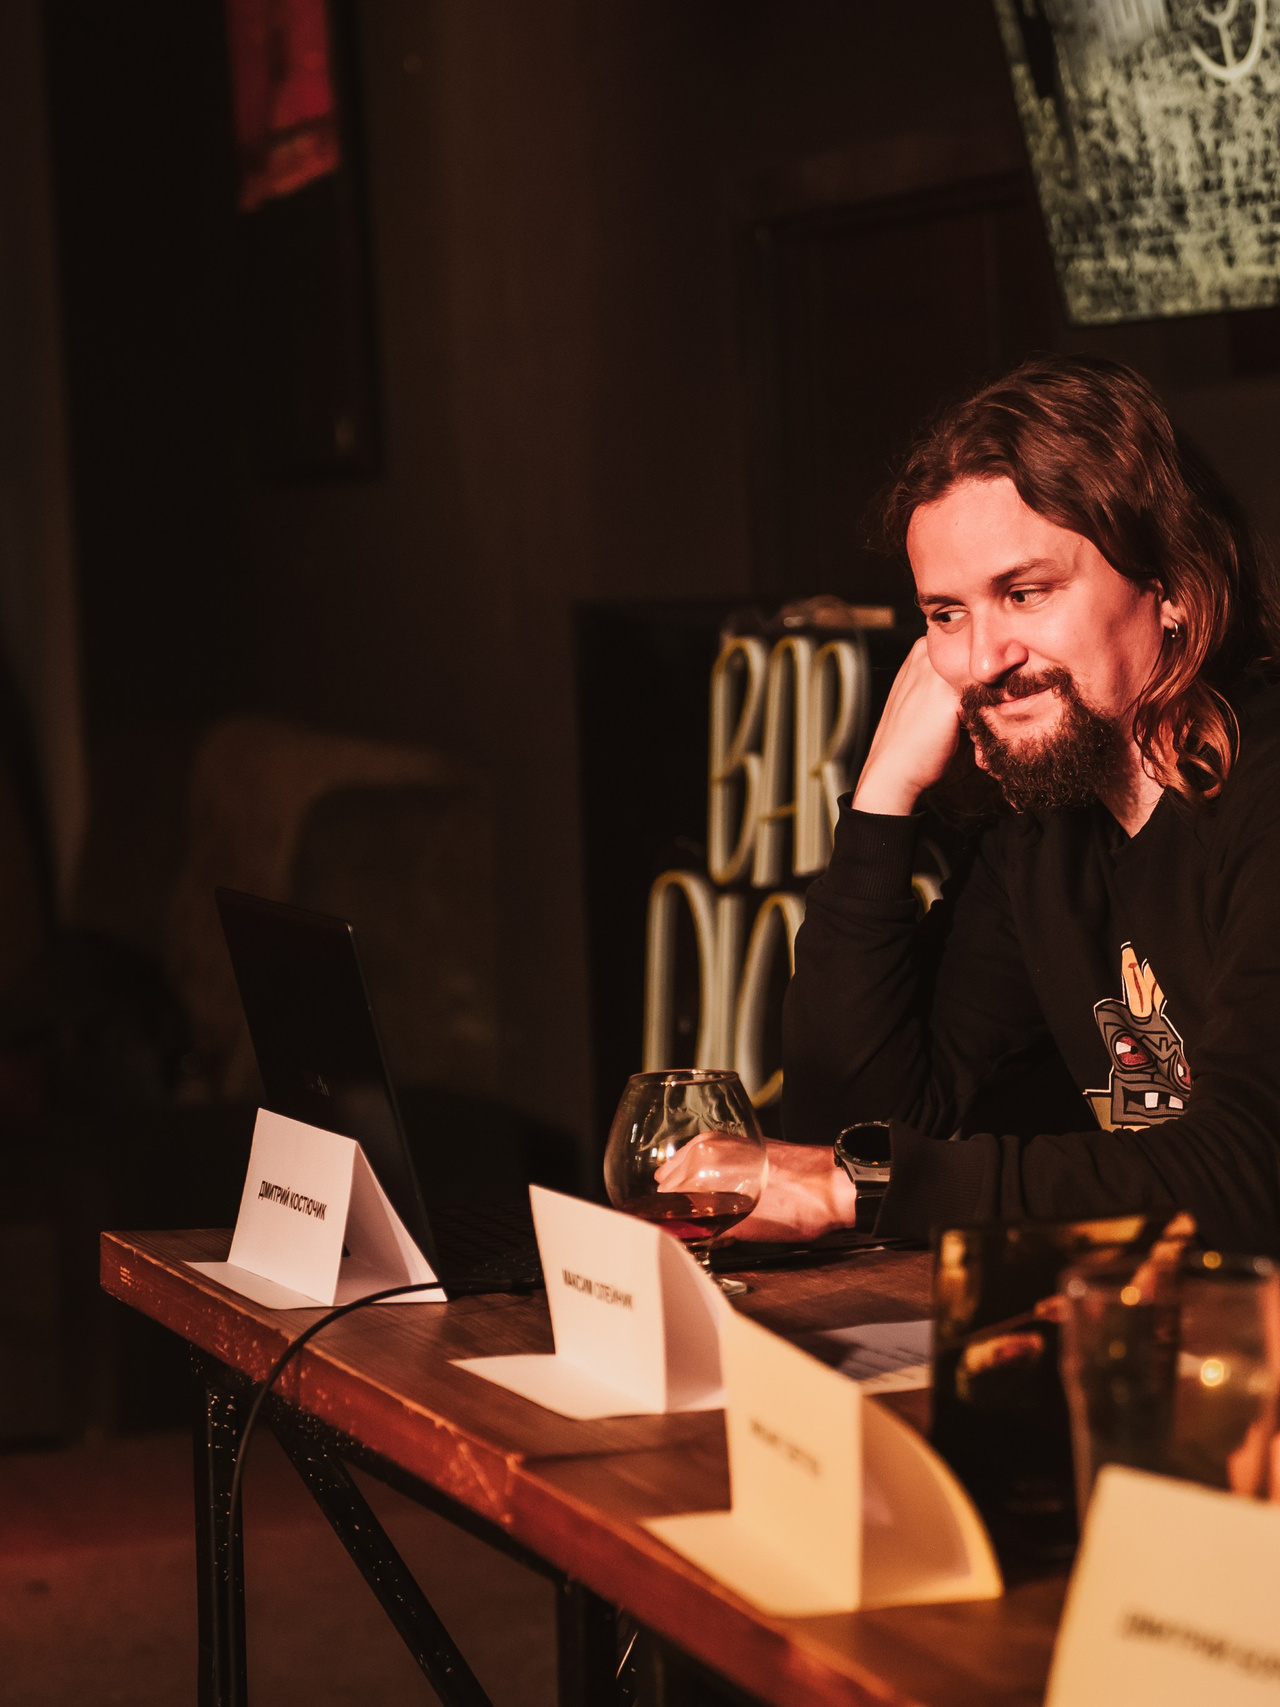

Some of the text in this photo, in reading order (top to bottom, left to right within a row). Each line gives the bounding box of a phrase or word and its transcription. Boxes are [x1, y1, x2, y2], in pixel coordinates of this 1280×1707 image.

[707, 634, 864, 891] BAR
[258, 1180, 327, 1221] ДМИТРИЙ КОСТЮЧИК
